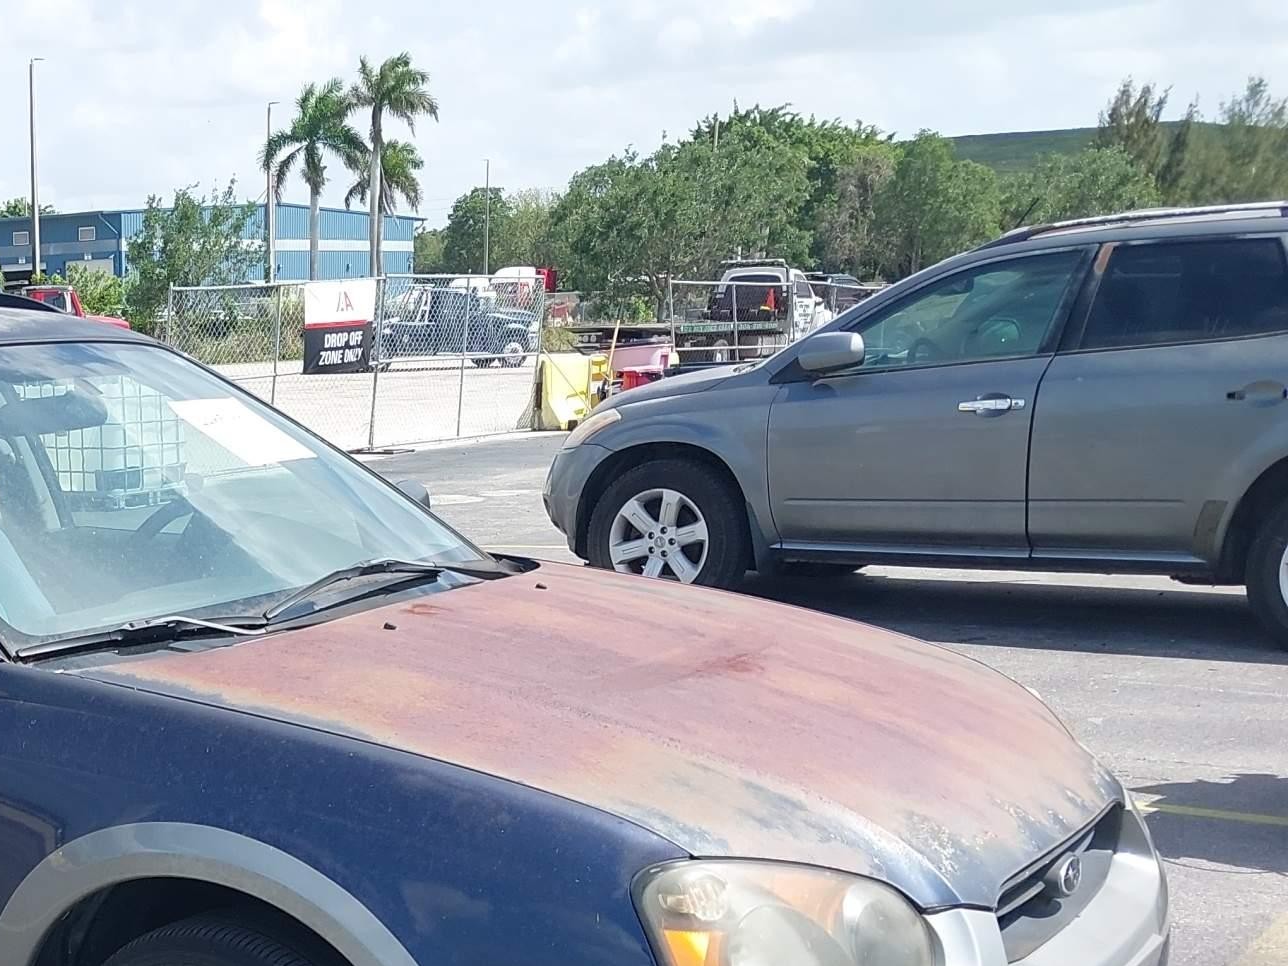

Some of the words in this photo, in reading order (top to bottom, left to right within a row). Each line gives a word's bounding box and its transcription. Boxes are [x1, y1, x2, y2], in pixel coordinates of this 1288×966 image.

[324, 332, 348, 348] DROP
[349, 331, 363, 346] OFF
[319, 350, 343, 366] ZONE
[344, 348, 363, 363] ONLY
